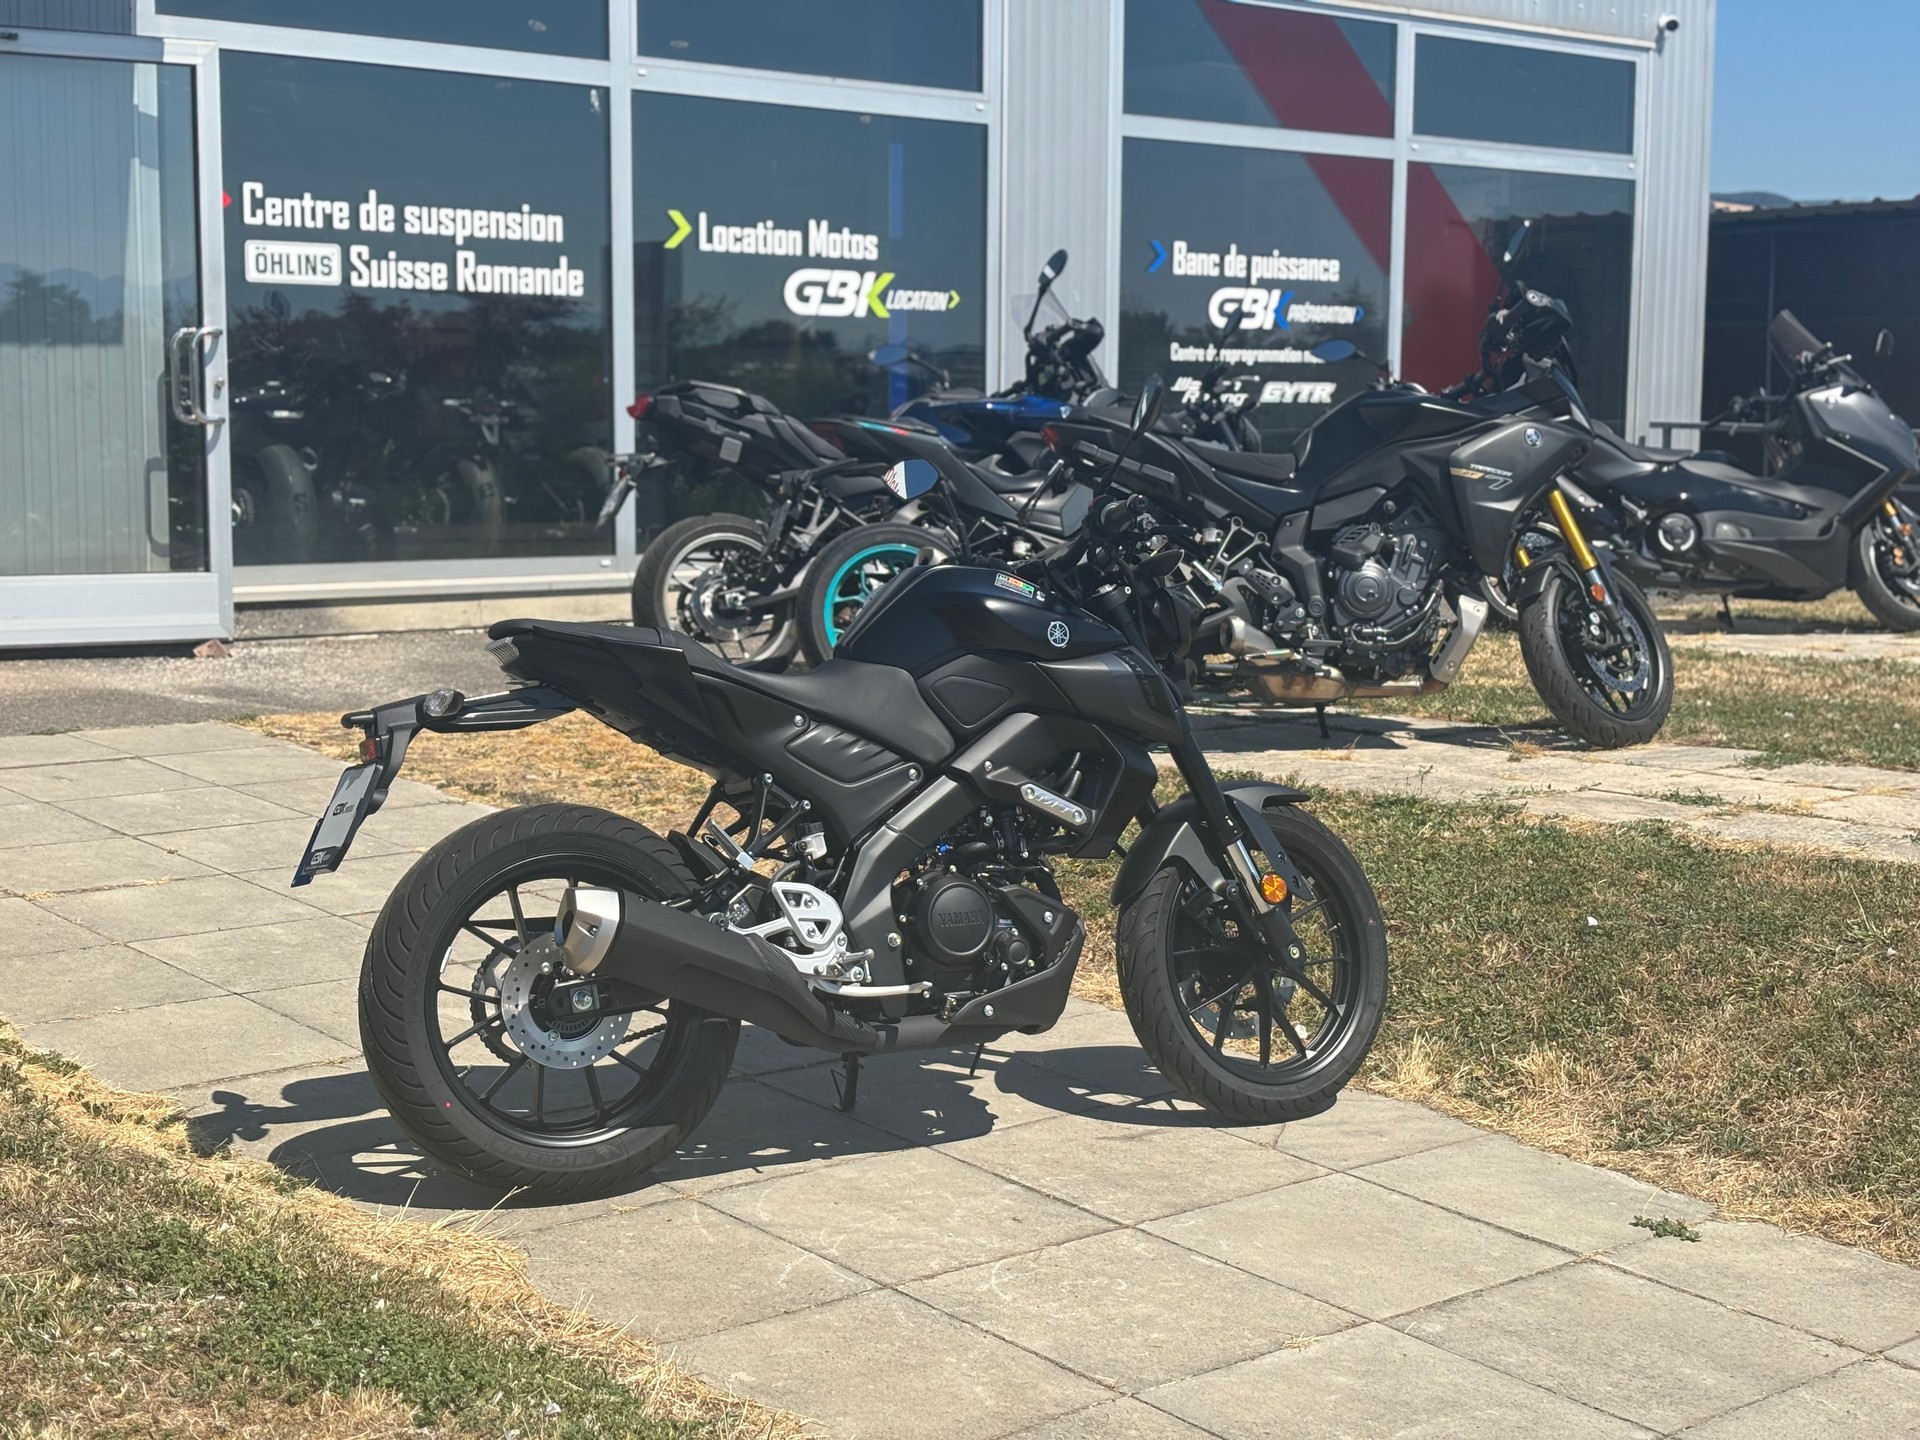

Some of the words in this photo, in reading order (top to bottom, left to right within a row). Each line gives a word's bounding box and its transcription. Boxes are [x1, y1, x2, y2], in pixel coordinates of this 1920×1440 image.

[242, 181, 350, 230] Centre
[359, 189, 395, 233] de
[404, 204, 563, 245] suspension
[699, 211, 802, 256] Location
[808, 218, 878, 261] Motos
[254, 246, 333, 276] ÖHLINS
[350, 244, 448, 291] Suisse
[456, 250, 584, 297] Romande
[1172, 240, 1220, 277] Banc
[1224, 243, 1247, 278] de
[1251, 249, 1340, 286] puissance
[783, 268, 895, 318] GBK
[885, 290, 950, 311] LOCATION
[1208, 286, 1294, 330] GBK
[1259, 381, 1337, 403] GYTR
[937, 909, 985, 928] YAMAHA
